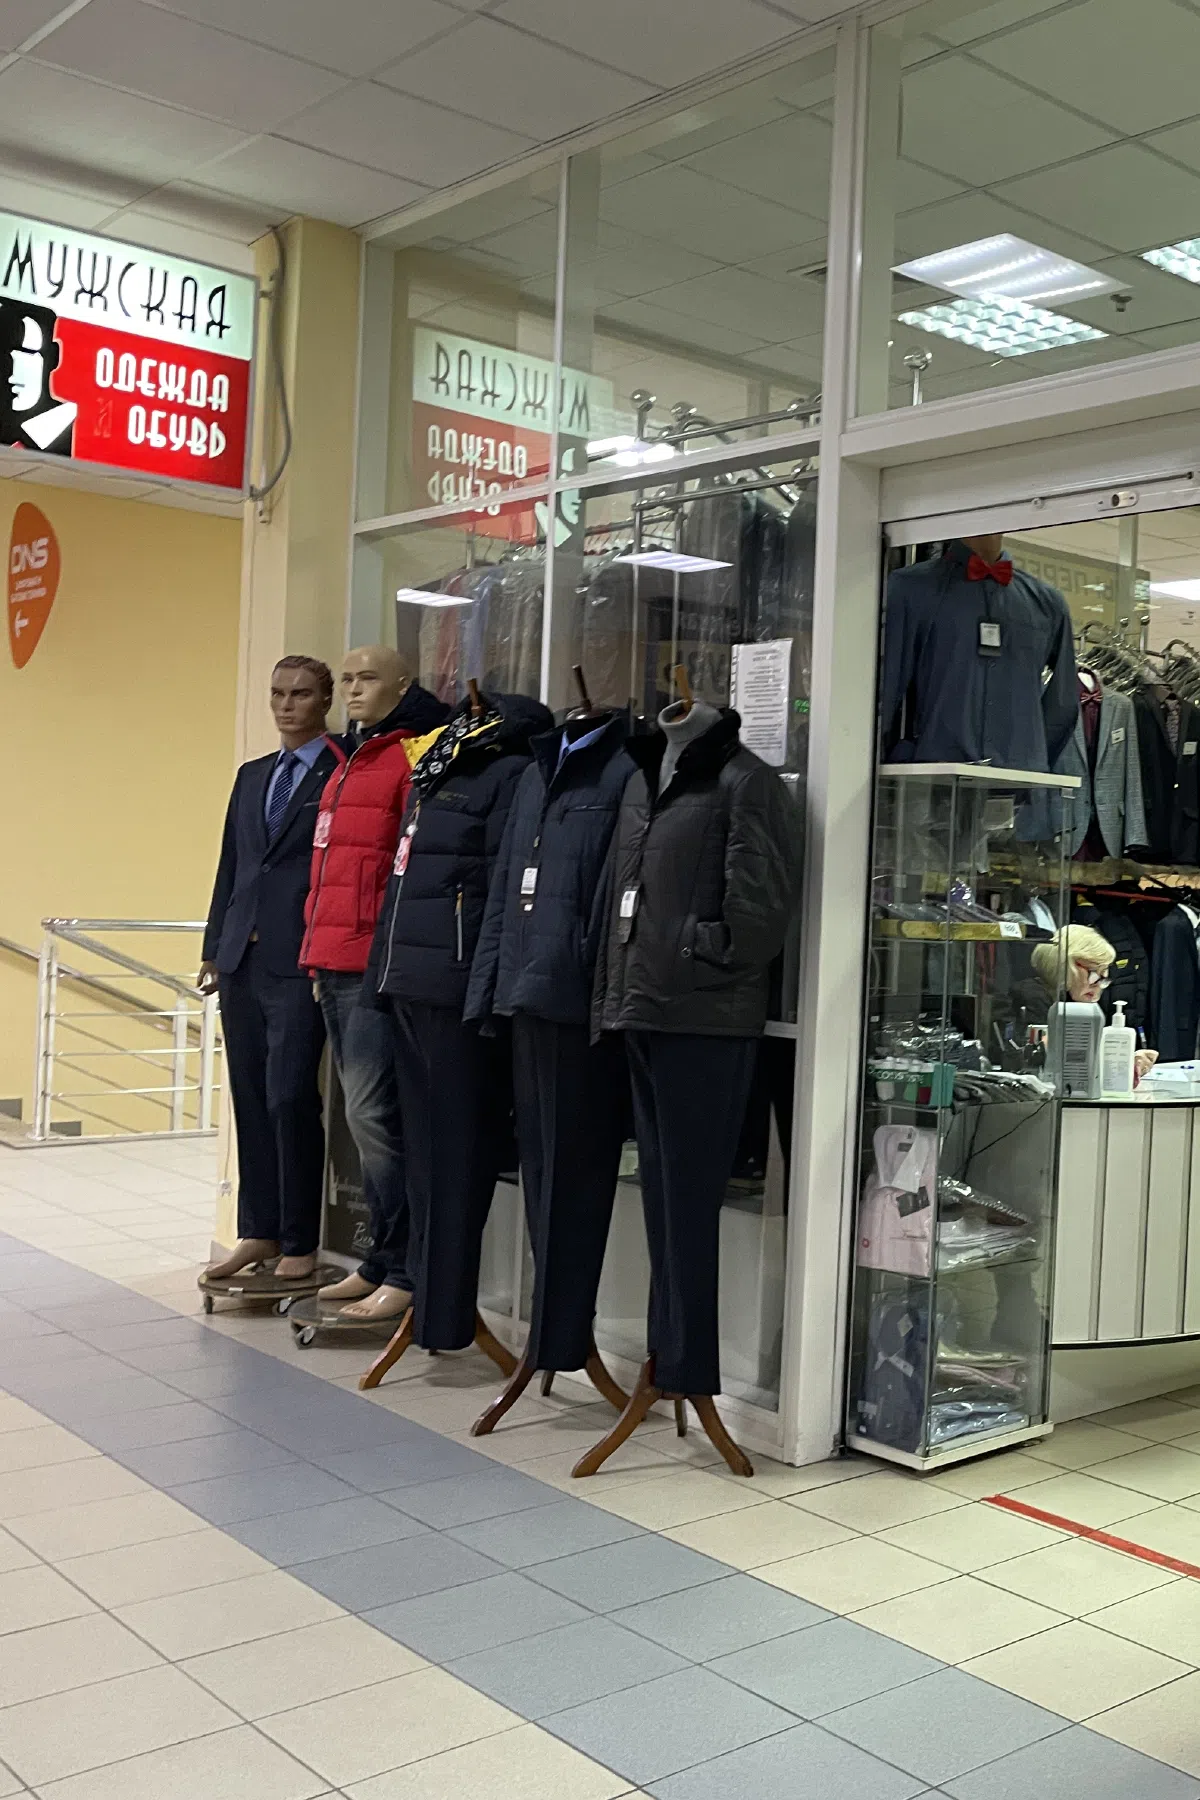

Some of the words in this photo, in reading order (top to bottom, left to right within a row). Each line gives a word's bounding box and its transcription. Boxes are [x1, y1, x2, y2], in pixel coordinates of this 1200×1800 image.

[2, 229, 231, 340] МУЖСКАЯ
[95, 347, 229, 413] ОДЕЖДА
[127, 404, 227, 459] ОБУВЬ
[11, 537, 49, 574] DNS
